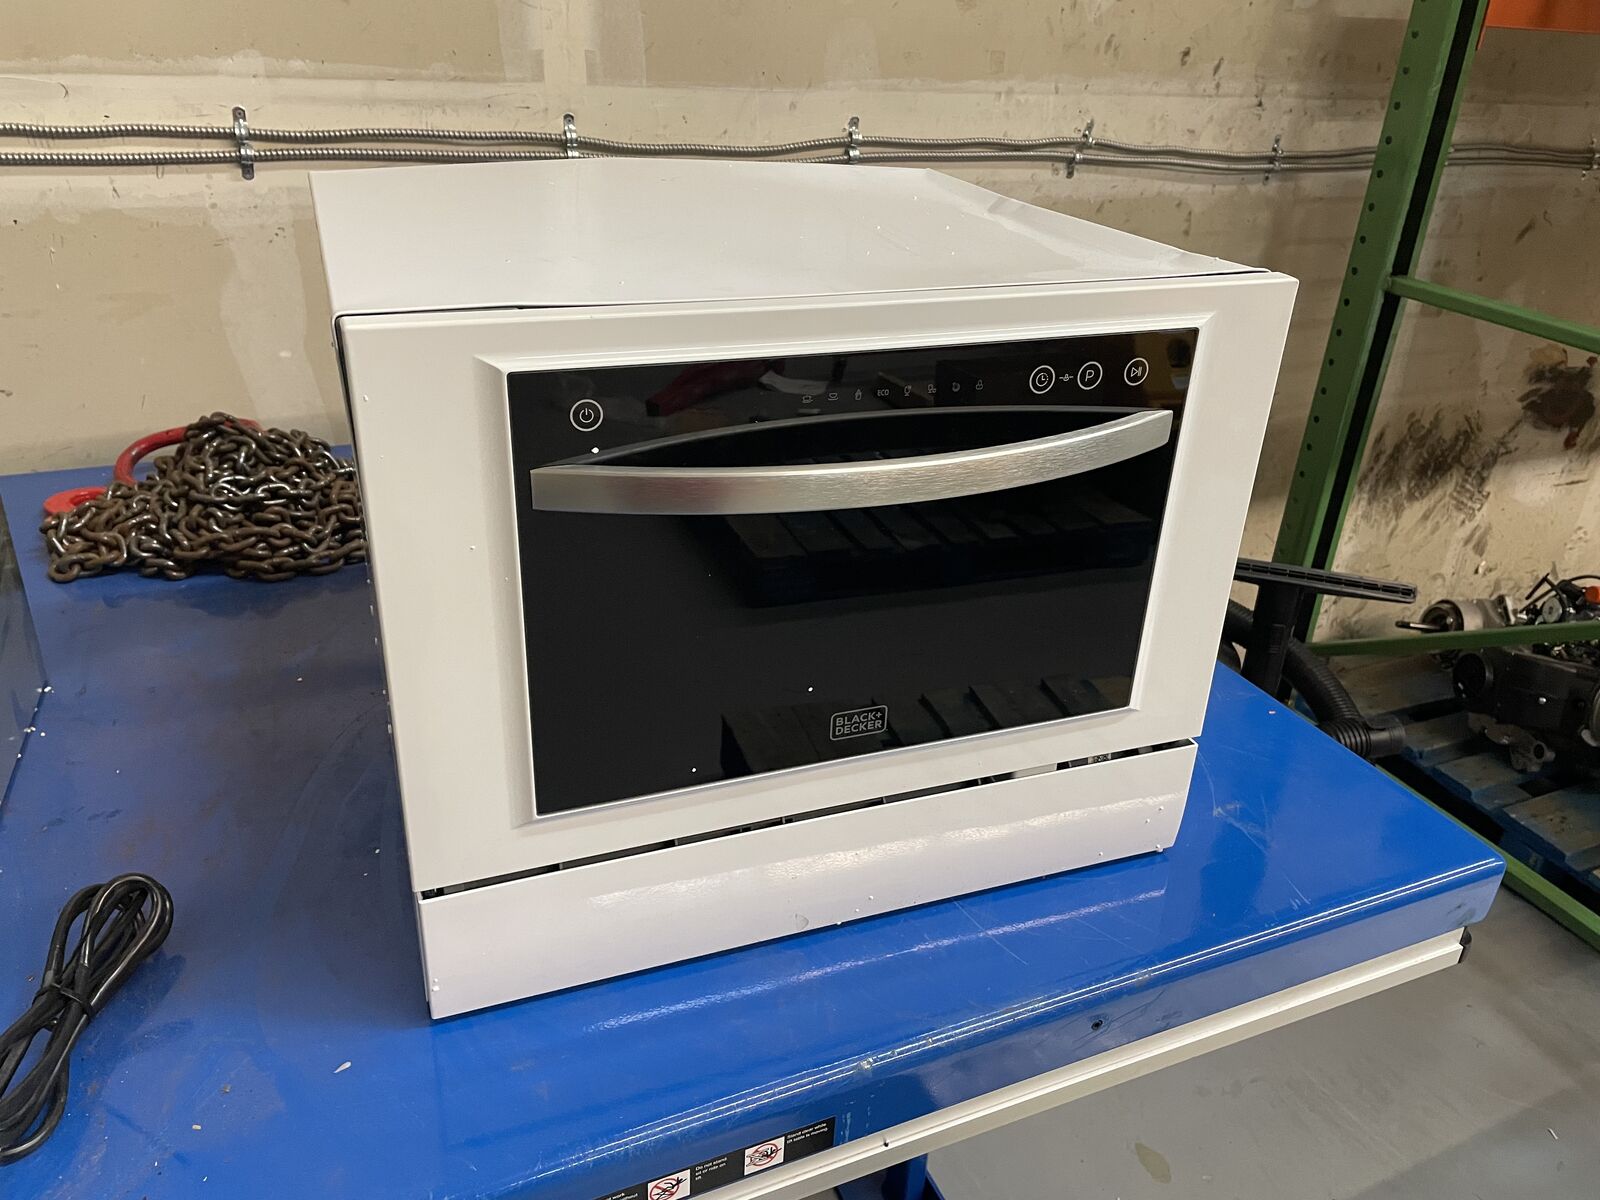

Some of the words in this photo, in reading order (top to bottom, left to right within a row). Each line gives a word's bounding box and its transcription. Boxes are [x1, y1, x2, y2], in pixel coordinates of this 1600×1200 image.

[877, 388, 890, 397] ECO
[835, 711, 882, 727] BLACK+
[835, 720, 882, 736] DECKER
[787, 1131, 802, 1139] Stand
[802, 1127, 814, 1135] clear
[810, 1127, 828, 1136] moving
[713, 1156, 728, 1165] stand
